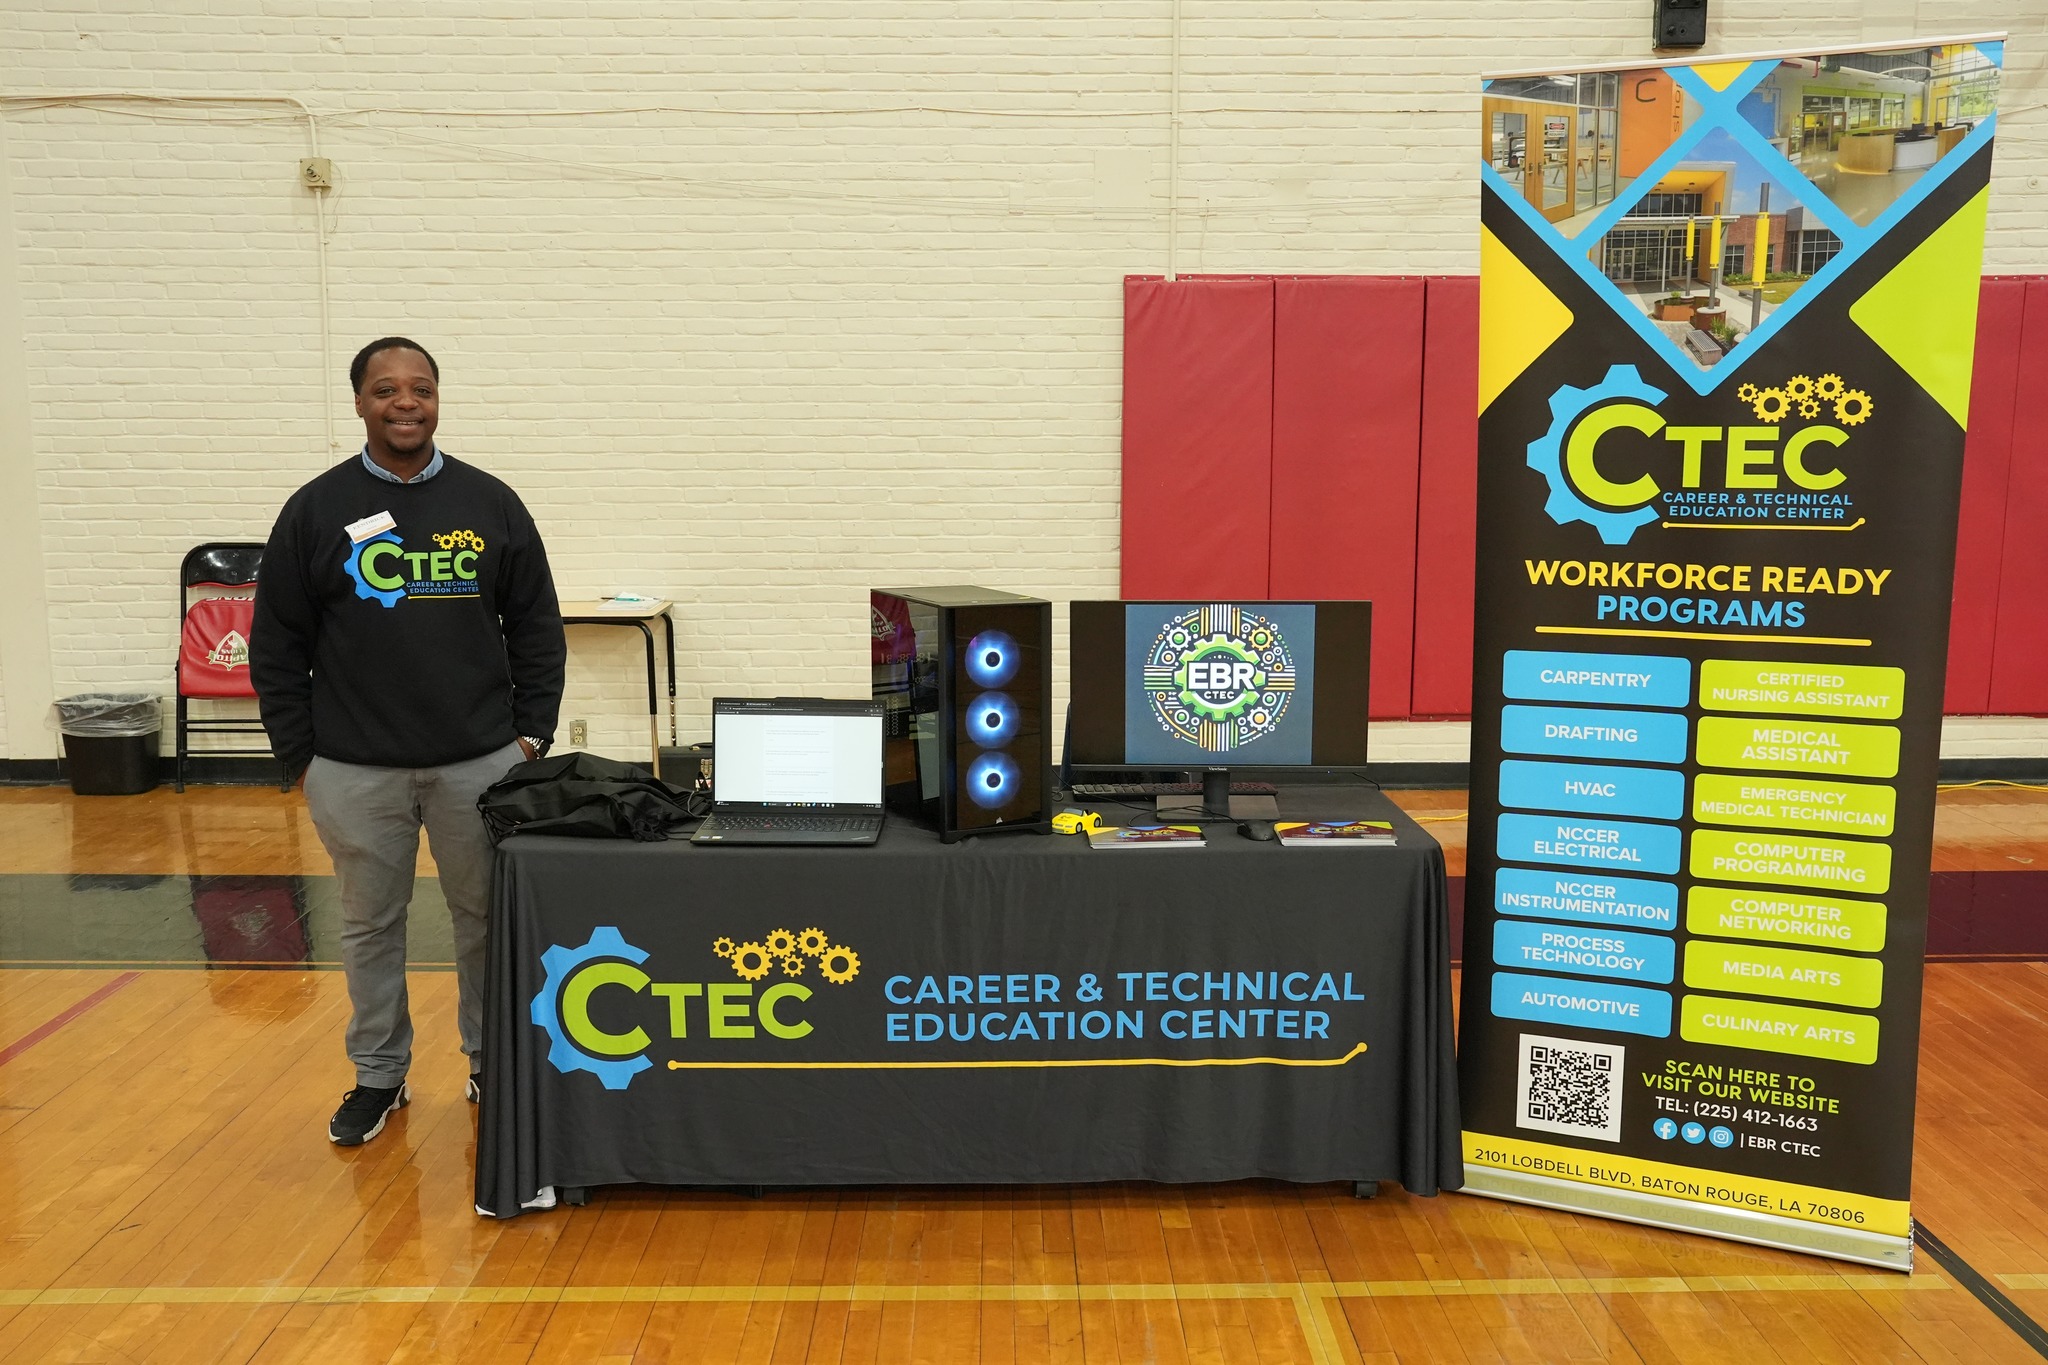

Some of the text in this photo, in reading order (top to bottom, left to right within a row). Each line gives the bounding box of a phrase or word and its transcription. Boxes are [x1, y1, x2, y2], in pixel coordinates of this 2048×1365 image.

[1636, 78, 1656, 102] C
[1673, 84, 1682, 132] sho
[1567, 404, 1850, 506] CTEC
[1663, 492, 1852, 505] CAREER & TECHNICAL
[1669, 505, 1845, 518] EDUCATION CENTER
[361, 542, 478, 589] CTEC
[1526, 560, 1890, 595] WORKFORCE READY
[1598, 595, 1805, 627] PROGRAMS
[1189, 663, 1256, 689] EBR
[1540, 670, 1651, 687] CARPENTRY
[1757, 672, 1845, 688] CERTIFIED
[1204, 691, 1234, 699] CTEC
[1713, 688, 1890, 707] NURSING ASSISTANT
[1545, 725, 1637, 742] DRAFTING
[1753, 729, 1840, 747] MEDICAL
[1742, 746, 1850, 764] ASSISTANT
[1565, 781, 1615, 797] HVAC
[1741, 787, 1846, 805] EMERGENCY
[1701, 801, 1886, 826] MEDICAL TECHNICIAN
[1558, 827, 1619, 843] NCCER
[1534, 841, 1641, 861] ELECTRICAL
[1734, 842, 1846, 863] COMPUTER
[1713, 857, 1866, 882] PROGRAMMING
[1556, 882, 1616, 898] NCCER
[1503, 893, 1669, 921] INSTRUMENTATION
[1731, 899, 1841, 921] COMPUTER
[1719, 915, 1851, 939] NETWORKING
[1542, 933, 1625, 953] PROCESS
[1521, 947, 1645, 971] TECHNOLOGY
[1723, 961, 1841, 986] MEDIA ARTS
[885, 971, 1365, 1004] CAREER & TECHNICAL
[563, 963, 813, 1055] CTEC
[1521, 992, 1639, 1016] AUTOMOTIVE
[887, 1009, 1330, 1041] EDUCATION CENTER
[1702, 1014, 1856, 1044] CULINARY ARTS
[1666, 1060, 1815, 1092] SCAN HERE TO
[1643, 1072, 1838, 1114] VISIT OUR WEBSITE
[1656, 1096, 1817, 1131] TEL: (225) 412-1663
[1749, 1136, 1820, 1157] EBR CTEC
[1475, 1149, 1864, 1223] 2101 LOBDELL BLVD, BATON ROUGE, LA 70806
